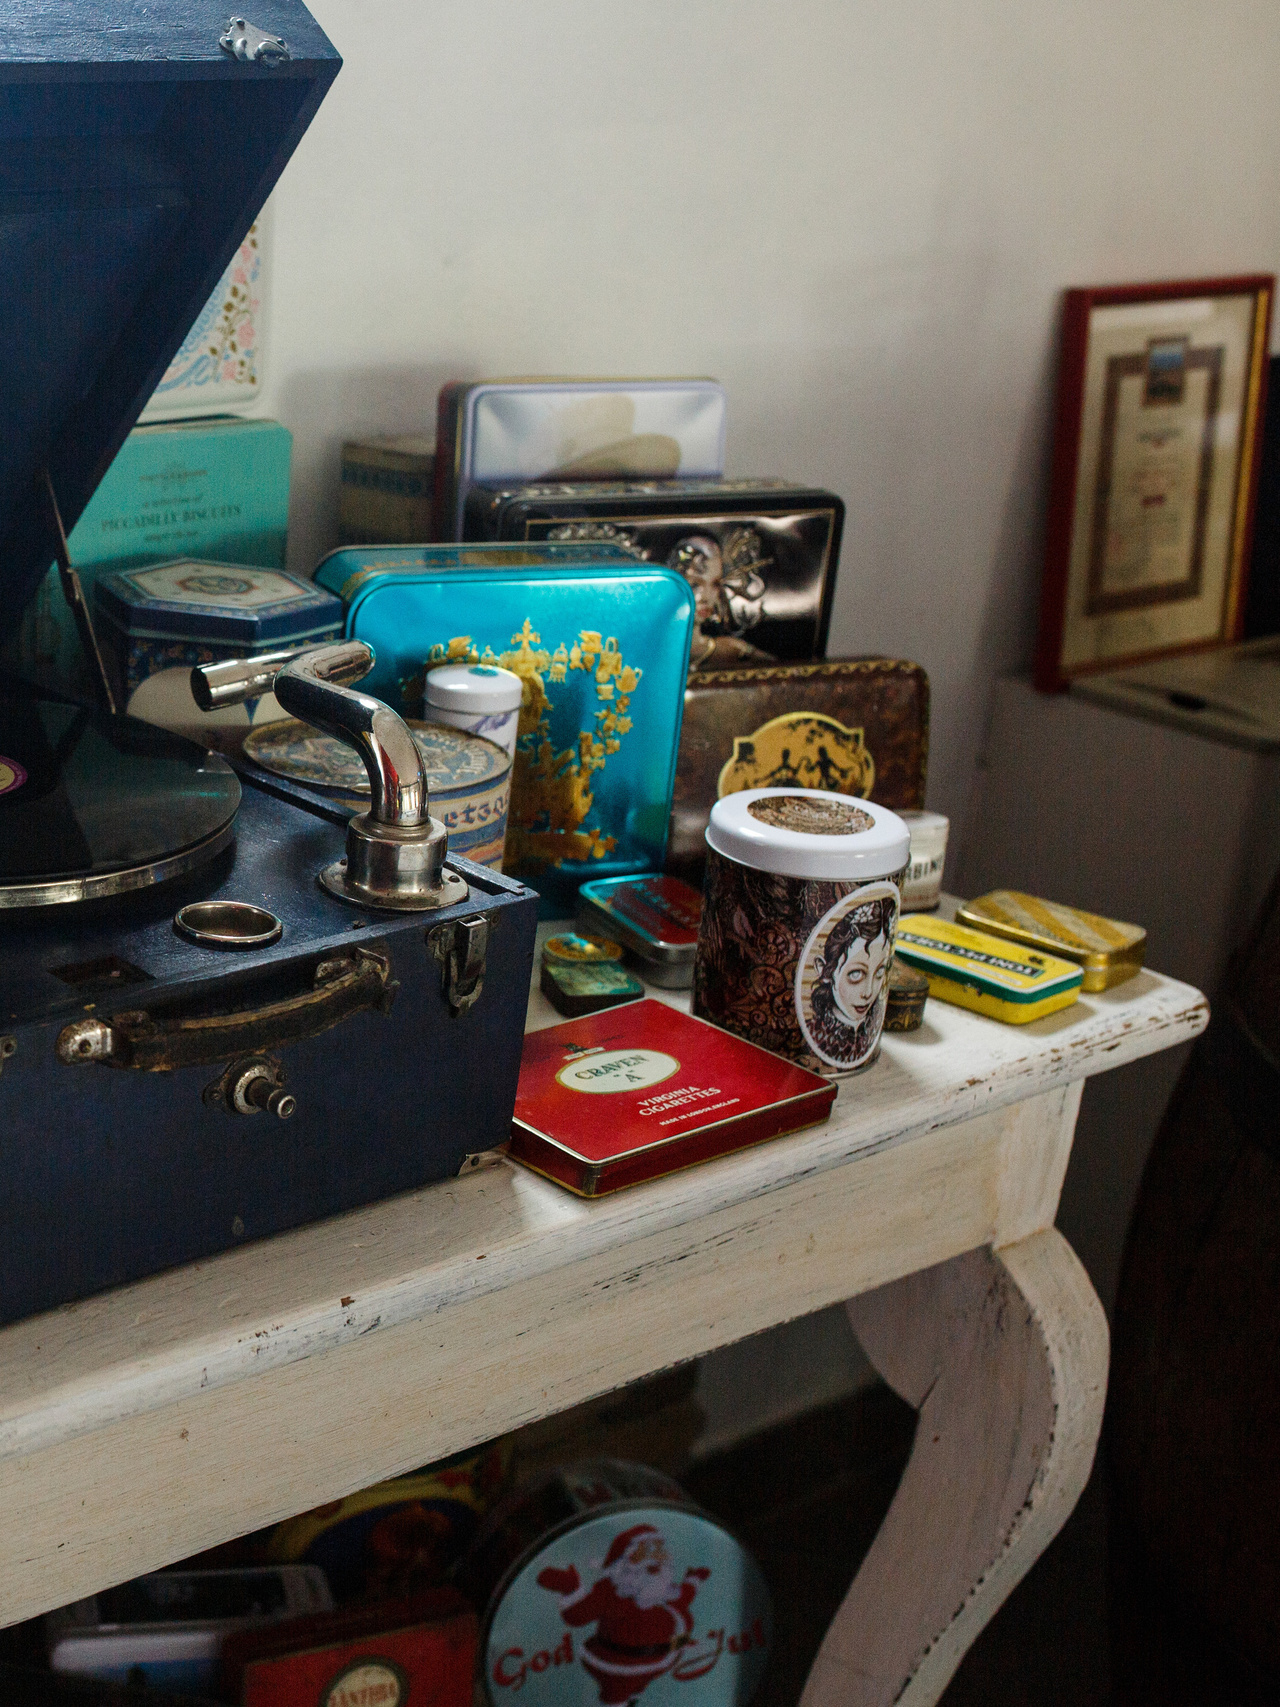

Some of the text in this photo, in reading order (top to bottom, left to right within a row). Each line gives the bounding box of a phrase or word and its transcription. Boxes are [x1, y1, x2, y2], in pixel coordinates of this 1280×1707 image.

[574, 1054, 649, 1081] CRAVEN
[636, 1084, 702, 1108] VIRGINIA
[638, 1086, 722, 1117] CIGARETTES
[659, 1116, 680, 1126] MADE
[491, 1617, 768, 1690] God Jul
